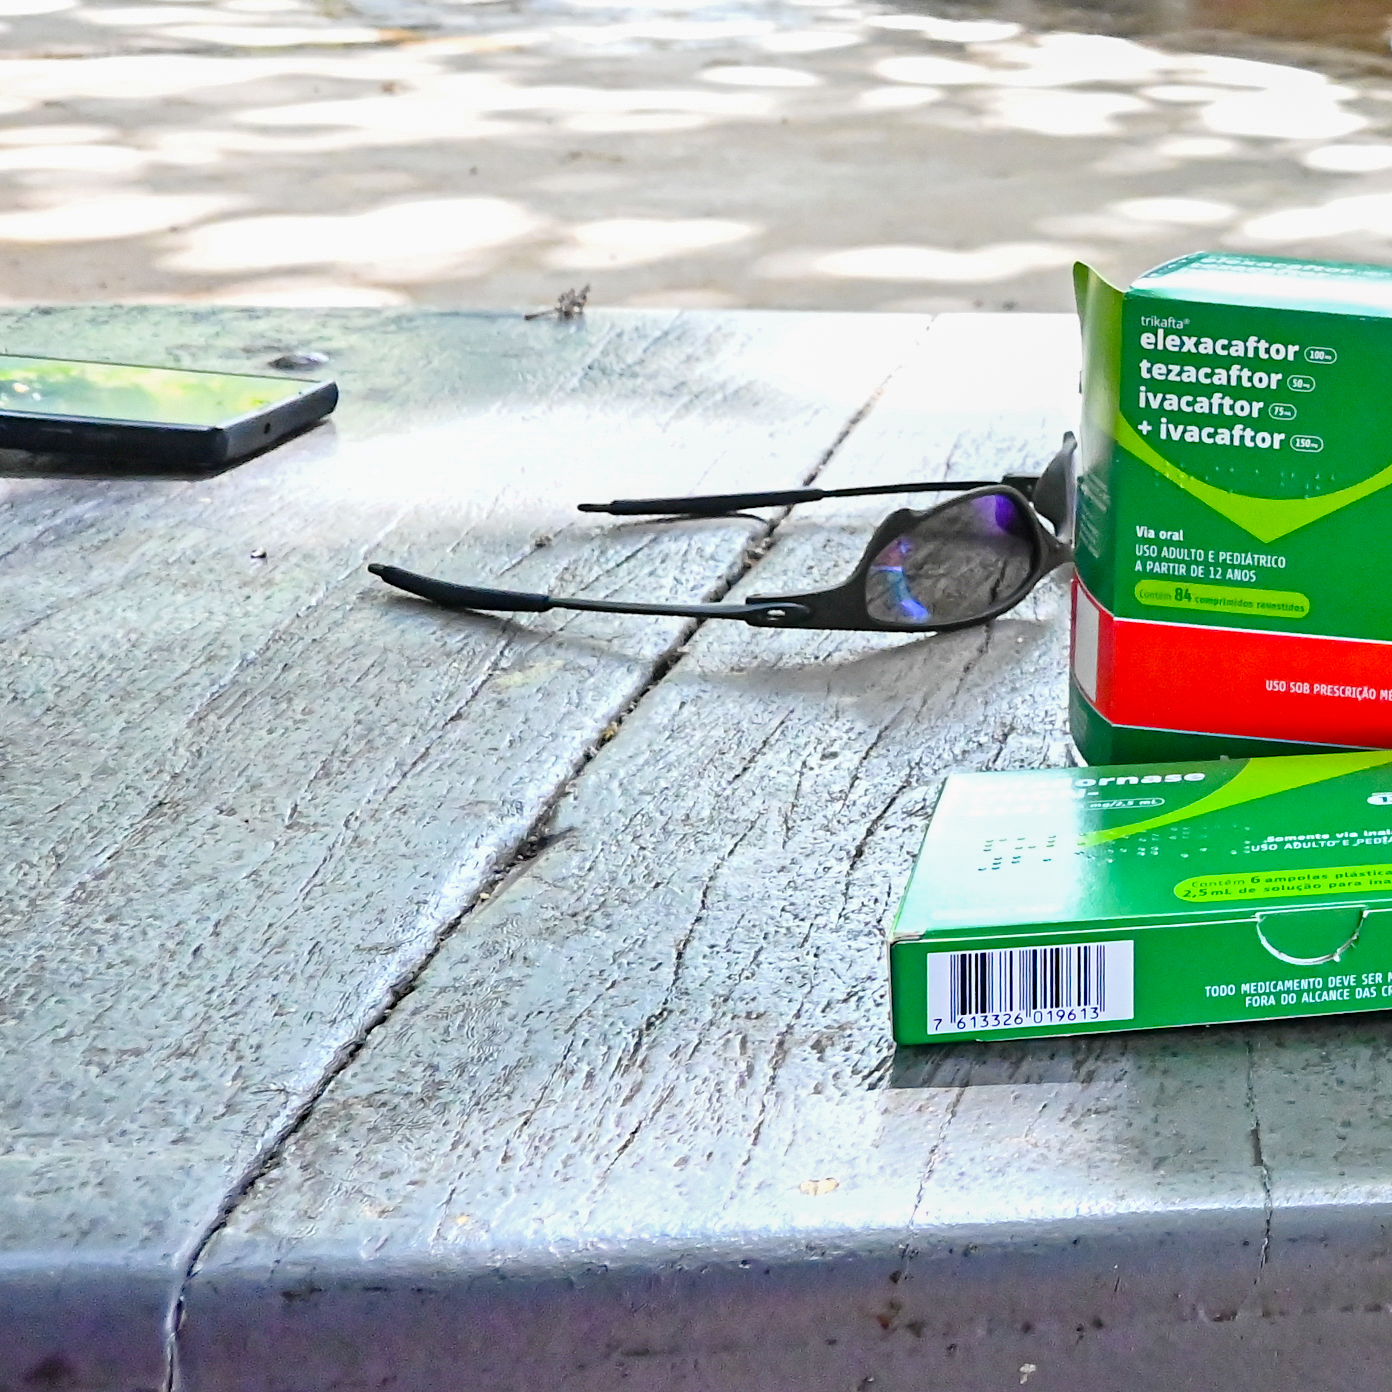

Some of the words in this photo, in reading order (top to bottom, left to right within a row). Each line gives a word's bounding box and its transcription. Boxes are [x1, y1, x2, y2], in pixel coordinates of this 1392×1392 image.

[1140, 328, 1299, 361] elexacaftor
[1139, 359, 1282, 389] tezacaftor
[1139, 386, 1264, 418] ivacaftor
[1160, 417, 1286, 449] ivacaftor
[1136, 525, 1155, 539] Via
[1159, 529, 1184, 541] oral
[1135, 544, 1158, 557] USO
[1161, 546, 1204, 562] ADULTO
[1208, 550, 1215, 562] E
[1219, 551, 1286, 569] PEDIÁTRICO
[1135, 560, 1142, 572] A
[1146, 561, 1186, 576] PARTIR
[1190, 565, 1205, 578] DE
[1209, 567, 1222, 579] 12
[1226, 568, 1256, 582] ANOS
[1174, 587, 1192, 603] 84
[1265, 680, 1286, 692] USO
[1290, 682, 1310, 694] SOB
[1313, 683, 1376, 701] PRESCRIÇÃO
[1074, 773, 1205, 787] ornase
[1251, 843, 1278, 852] USO
[1284, 840, 1336, 850] ADULTO
[1266, 833, 1330, 843] Somente
[1336, 831, 1358, 839] via
[1250, 876, 1260, 884] 6
[1265, 873, 1328, 883] ampolas
[1264, 883, 1321, 892] solução
[1329, 881, 1362, 890] para
[1205, 984, 1236, 998] TODO
[1241, 977, 1323, 995] MEDICAMENTO
[1328, 974, 1357, 988] DEVE
[1361, 972, 1383, 985] SER
[1245, 995, 1276, 1008] FORA
[1281, 993, 1297, 1005] DO
[1301, 989, 1350, 1004] ALCANCE
[1355, 986, 1377, 1000] DAS
[933, 1018, 943, 1031] 7
[957, 1013, 1024, 1030] 613326
[1033, 1007, 1099, 1024] 019613
